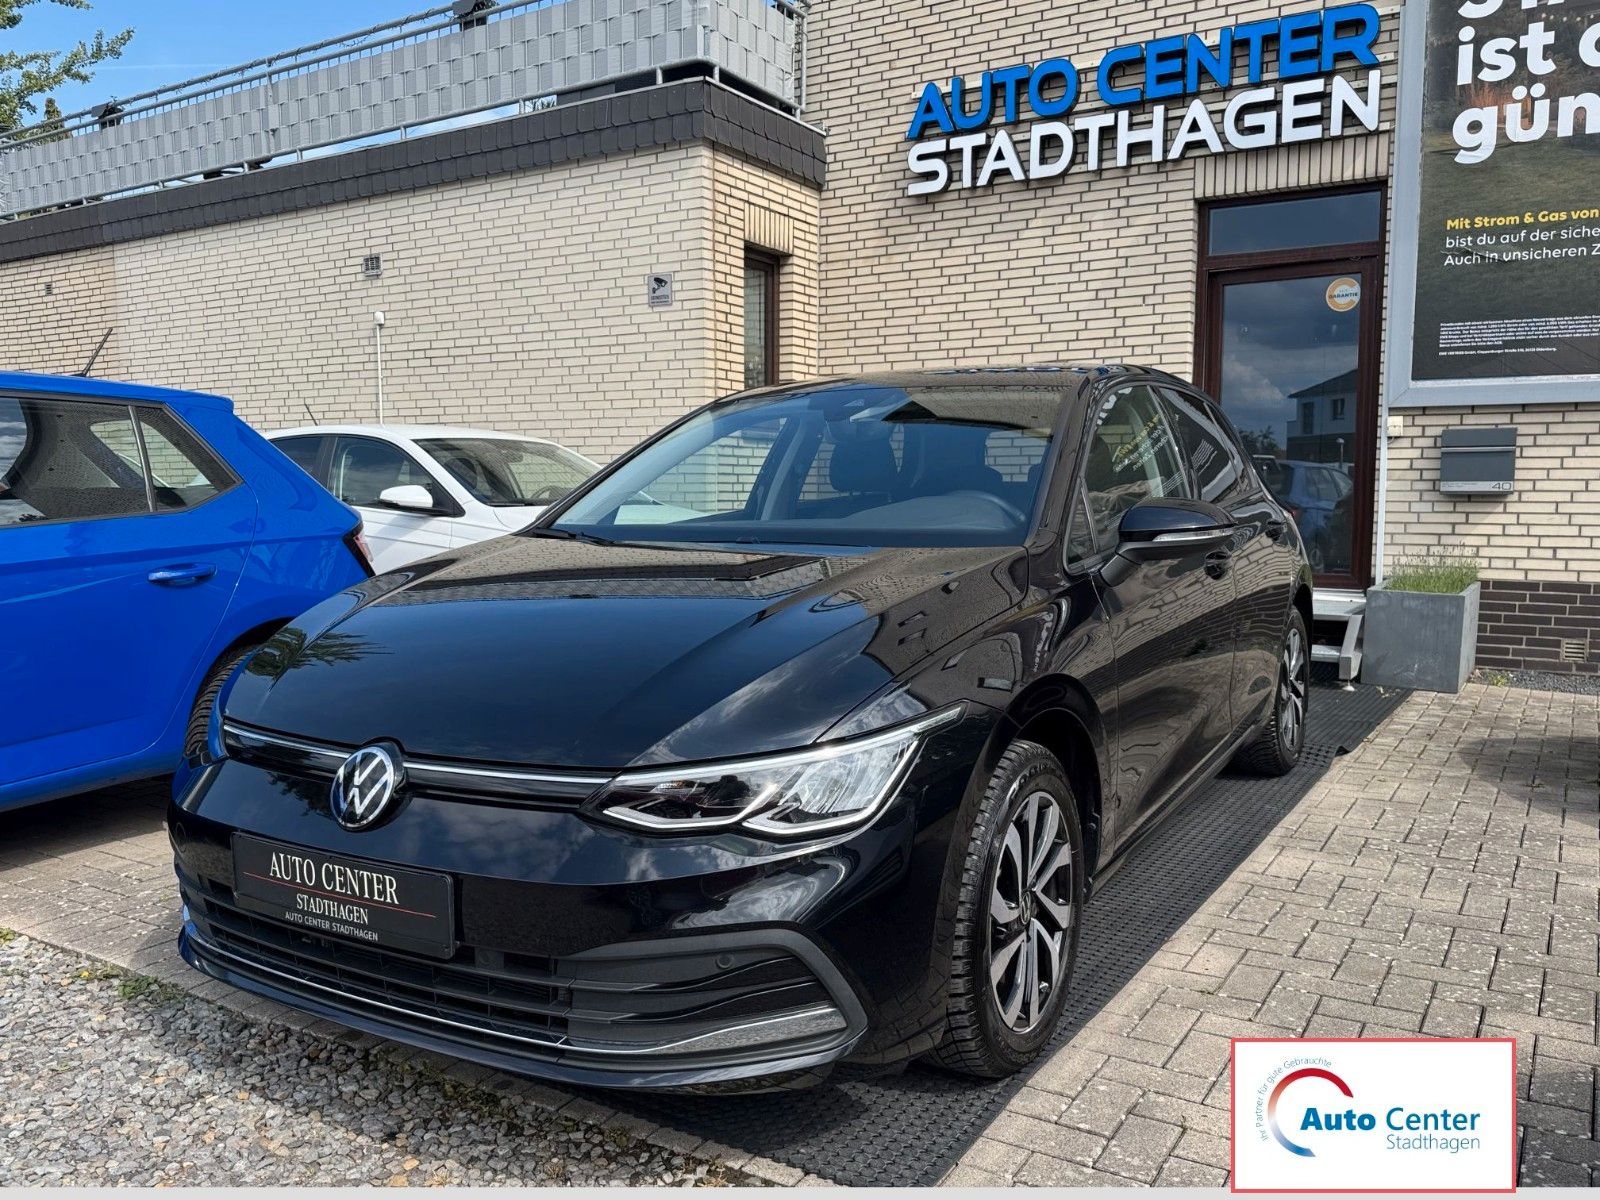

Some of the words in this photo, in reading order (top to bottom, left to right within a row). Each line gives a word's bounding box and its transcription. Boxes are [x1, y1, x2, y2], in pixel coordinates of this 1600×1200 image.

[1457, 22, 1557, 86] ist
[907, 58, 1080, 140] AUTO
[1097, 3, 1380, 106] CENTER
[907, 70, 1381, 196] STADTHAGEN
[1446, 217, 1471, 230] Mit
[1474, 215, 1520, 228] Strom
[1524, 212, 1534, 224] &
[1538, 210, 1567, 222] Gas
[1571, 209, 1599, 220] von
[1446, 236, 1473, 248] bist
[1477, 233, 1496, 245] du
[1500, 230, 1527, 243] auf
[1529, 228, 1556, 241] der
[1444, 251, 1481, 266] Auch
[1485, 251, 1498, 263] in
[1502, 246, 1587, 262] unsicheren
[1328, 292, 1358, 300] GARANTIE
[1491, 482, 1512, 491] 40
[269, 852, 316, 886] AUTO
[321, 862, 399, 905] CENTER
[296, 893, 369, 925] STADTHAGEN
[285, 911, 303, 923] AUTO
[304, 915, 331, 930] CENTER
[331, 922, 378, 941] STADTHAGEN
